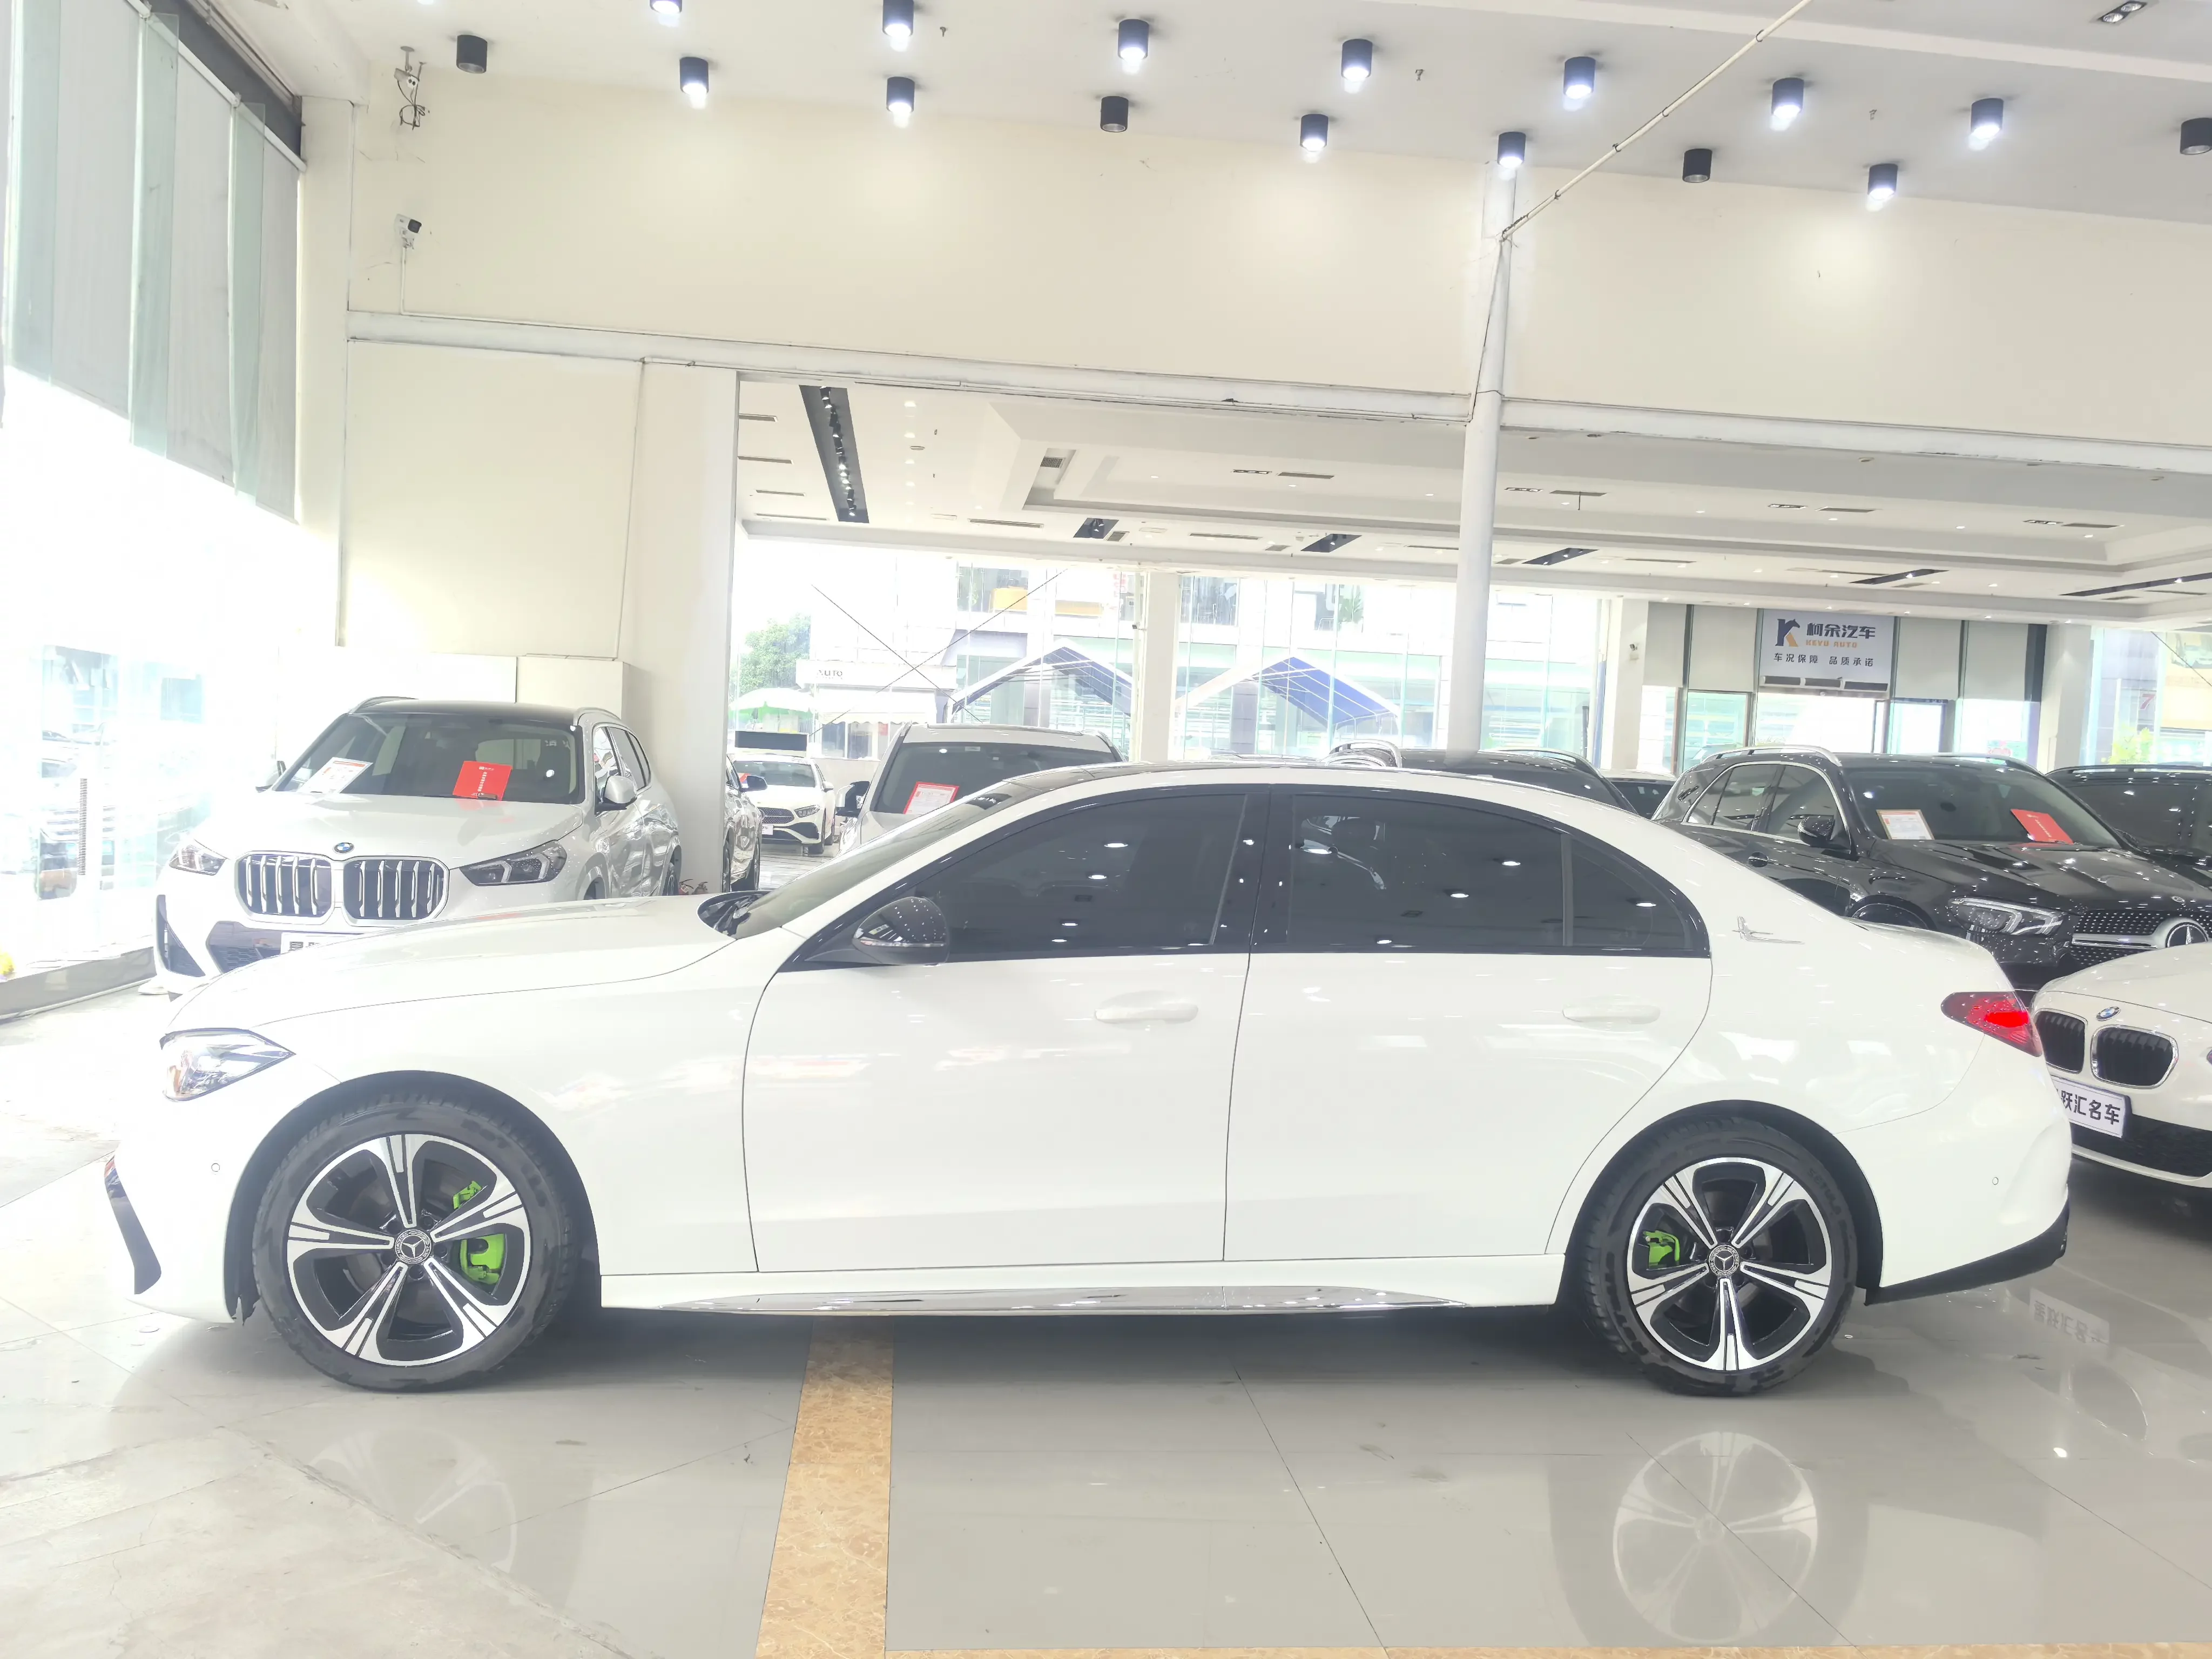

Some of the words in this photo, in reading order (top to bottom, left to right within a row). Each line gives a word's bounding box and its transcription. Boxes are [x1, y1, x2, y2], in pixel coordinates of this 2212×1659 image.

[1774, 652, 1818, 664] 车况保障
[1829, 656, 1874, 667] 品质承诺
[2056, 1088, 2121, 1125] 跃汇名车
